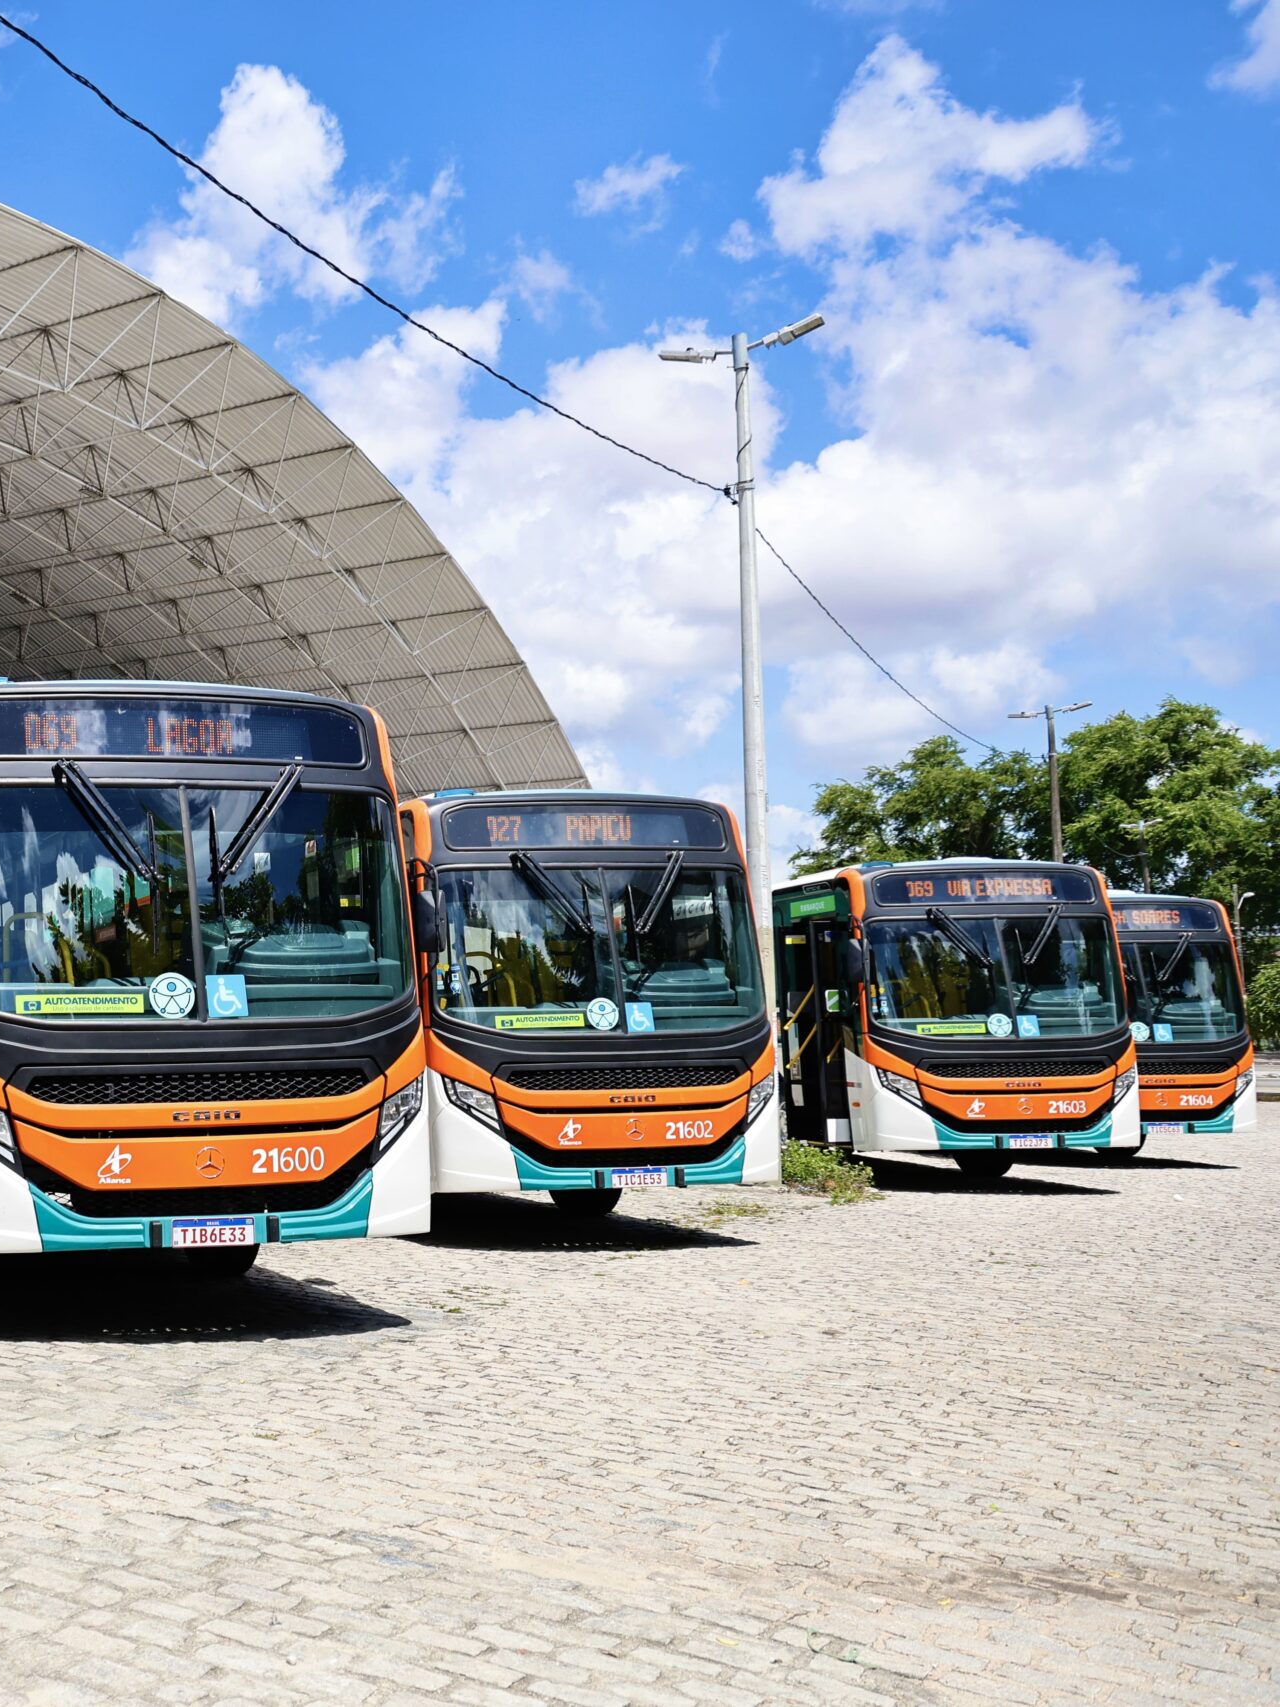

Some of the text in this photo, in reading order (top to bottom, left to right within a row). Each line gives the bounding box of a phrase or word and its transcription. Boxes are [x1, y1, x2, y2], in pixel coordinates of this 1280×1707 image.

[23, 712, 234, 754] 069 LAGOA
[566, 815, 632, 842] PAPICU
[946, 878, 972, 897] VIA
[975, 877, 1052, 897] EXPRESSA
[1131, 909, 1180, 924] SOARES
[44, 997, 138, 1006] AUTOATENDIMENTO
[515, 1015, 580, 1023] AUTOATENDIMENTO
[1048, 1100, 1087, 1114] 21603
[1180, 1095, 1214, 1106] 21604
[665, 1120, 714, 1140] 21602
[252, 1146, 325, 1174] 21600
[616, 1173, 662, 1186] TIC1E53
[180, 1226, 246, 1244] TIB6E33
